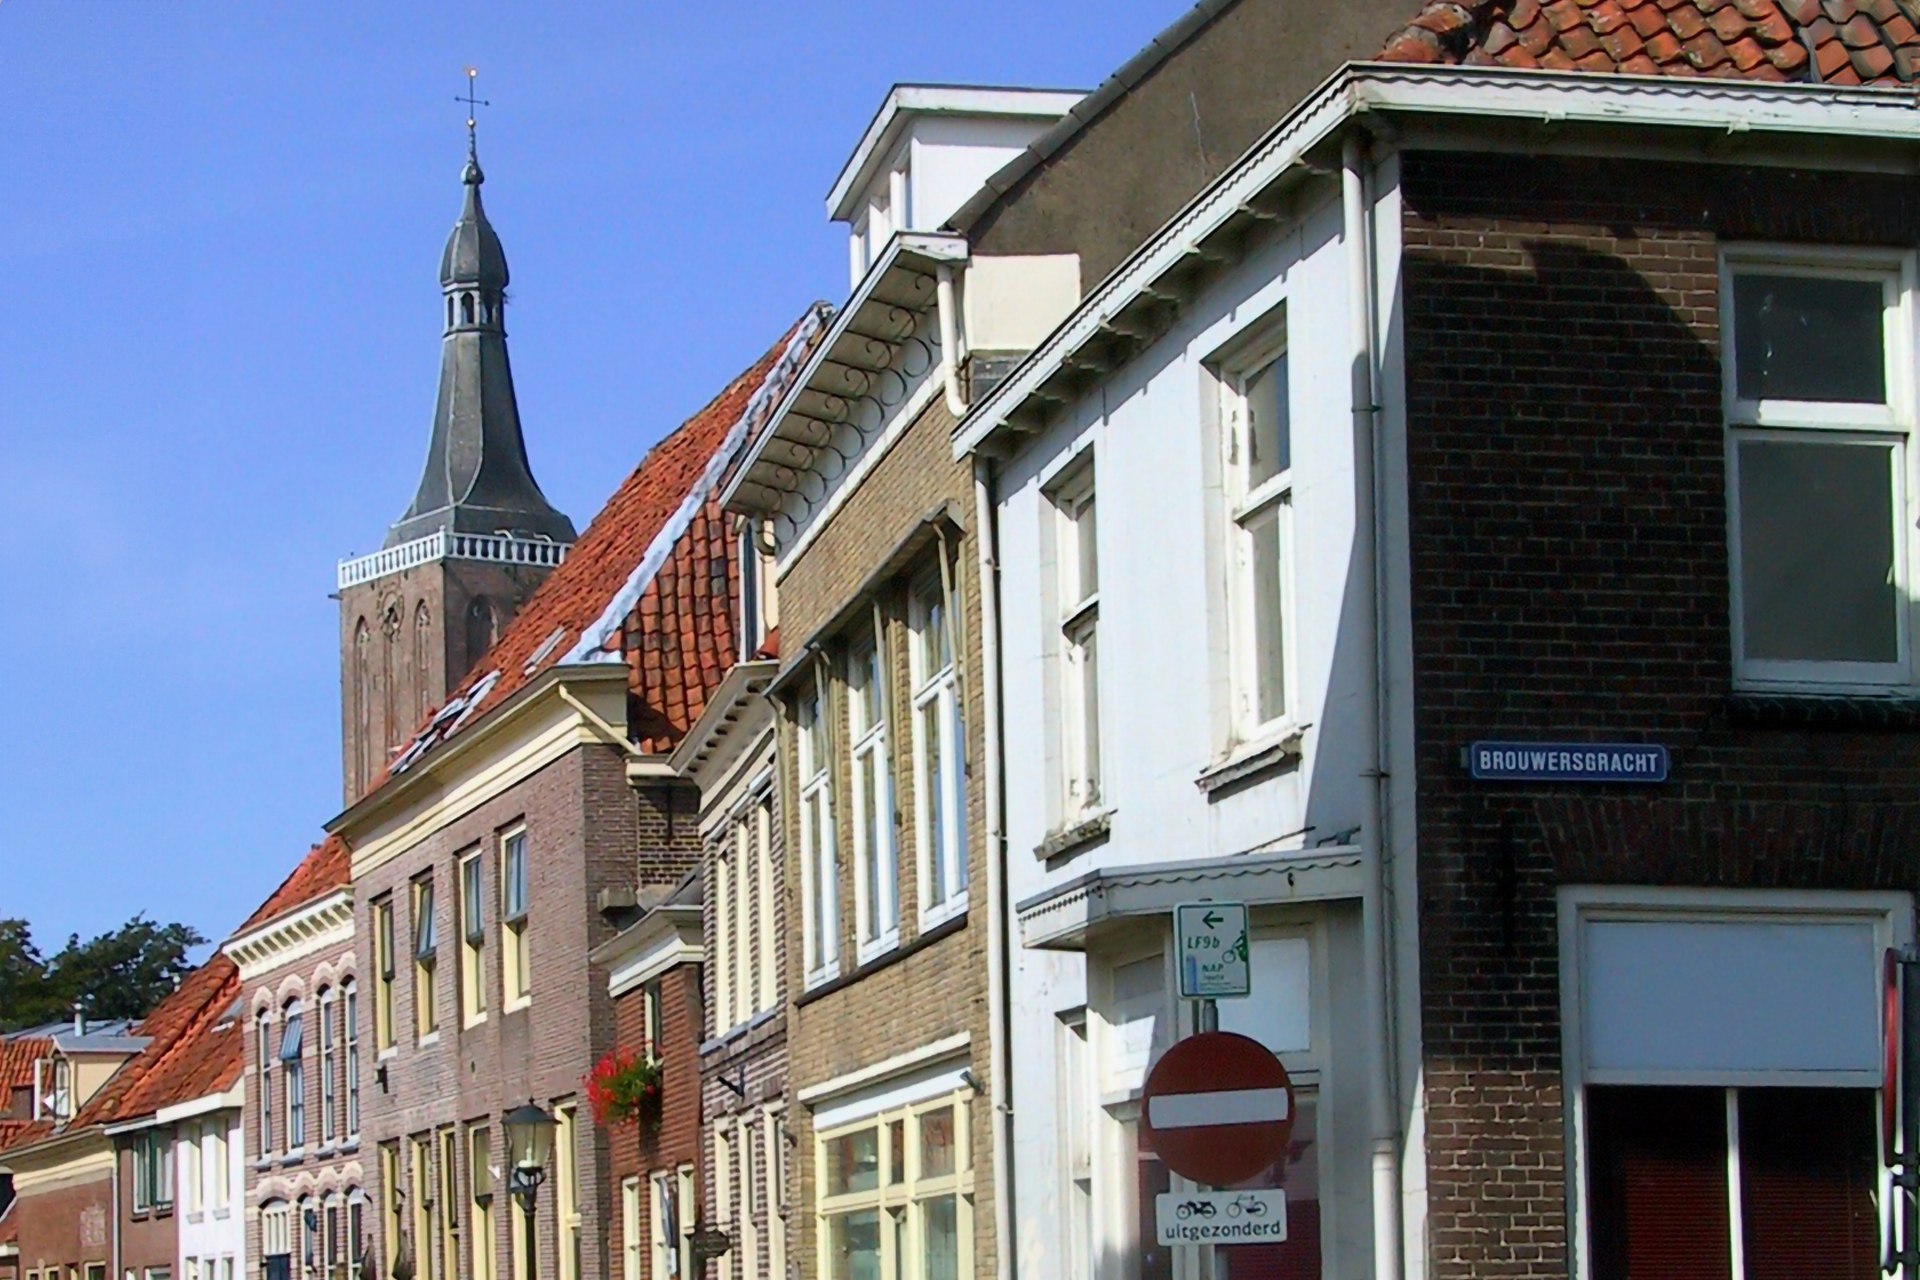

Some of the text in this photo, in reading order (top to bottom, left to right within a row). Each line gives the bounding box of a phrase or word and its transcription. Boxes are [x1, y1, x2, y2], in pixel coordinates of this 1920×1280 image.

[1480, 751, 1658, 772] BROUWERSGRACHT
[1187, 936, 1220, 949] LF9b
[1166, 1220, 1280, 1241] uitgezonderd
